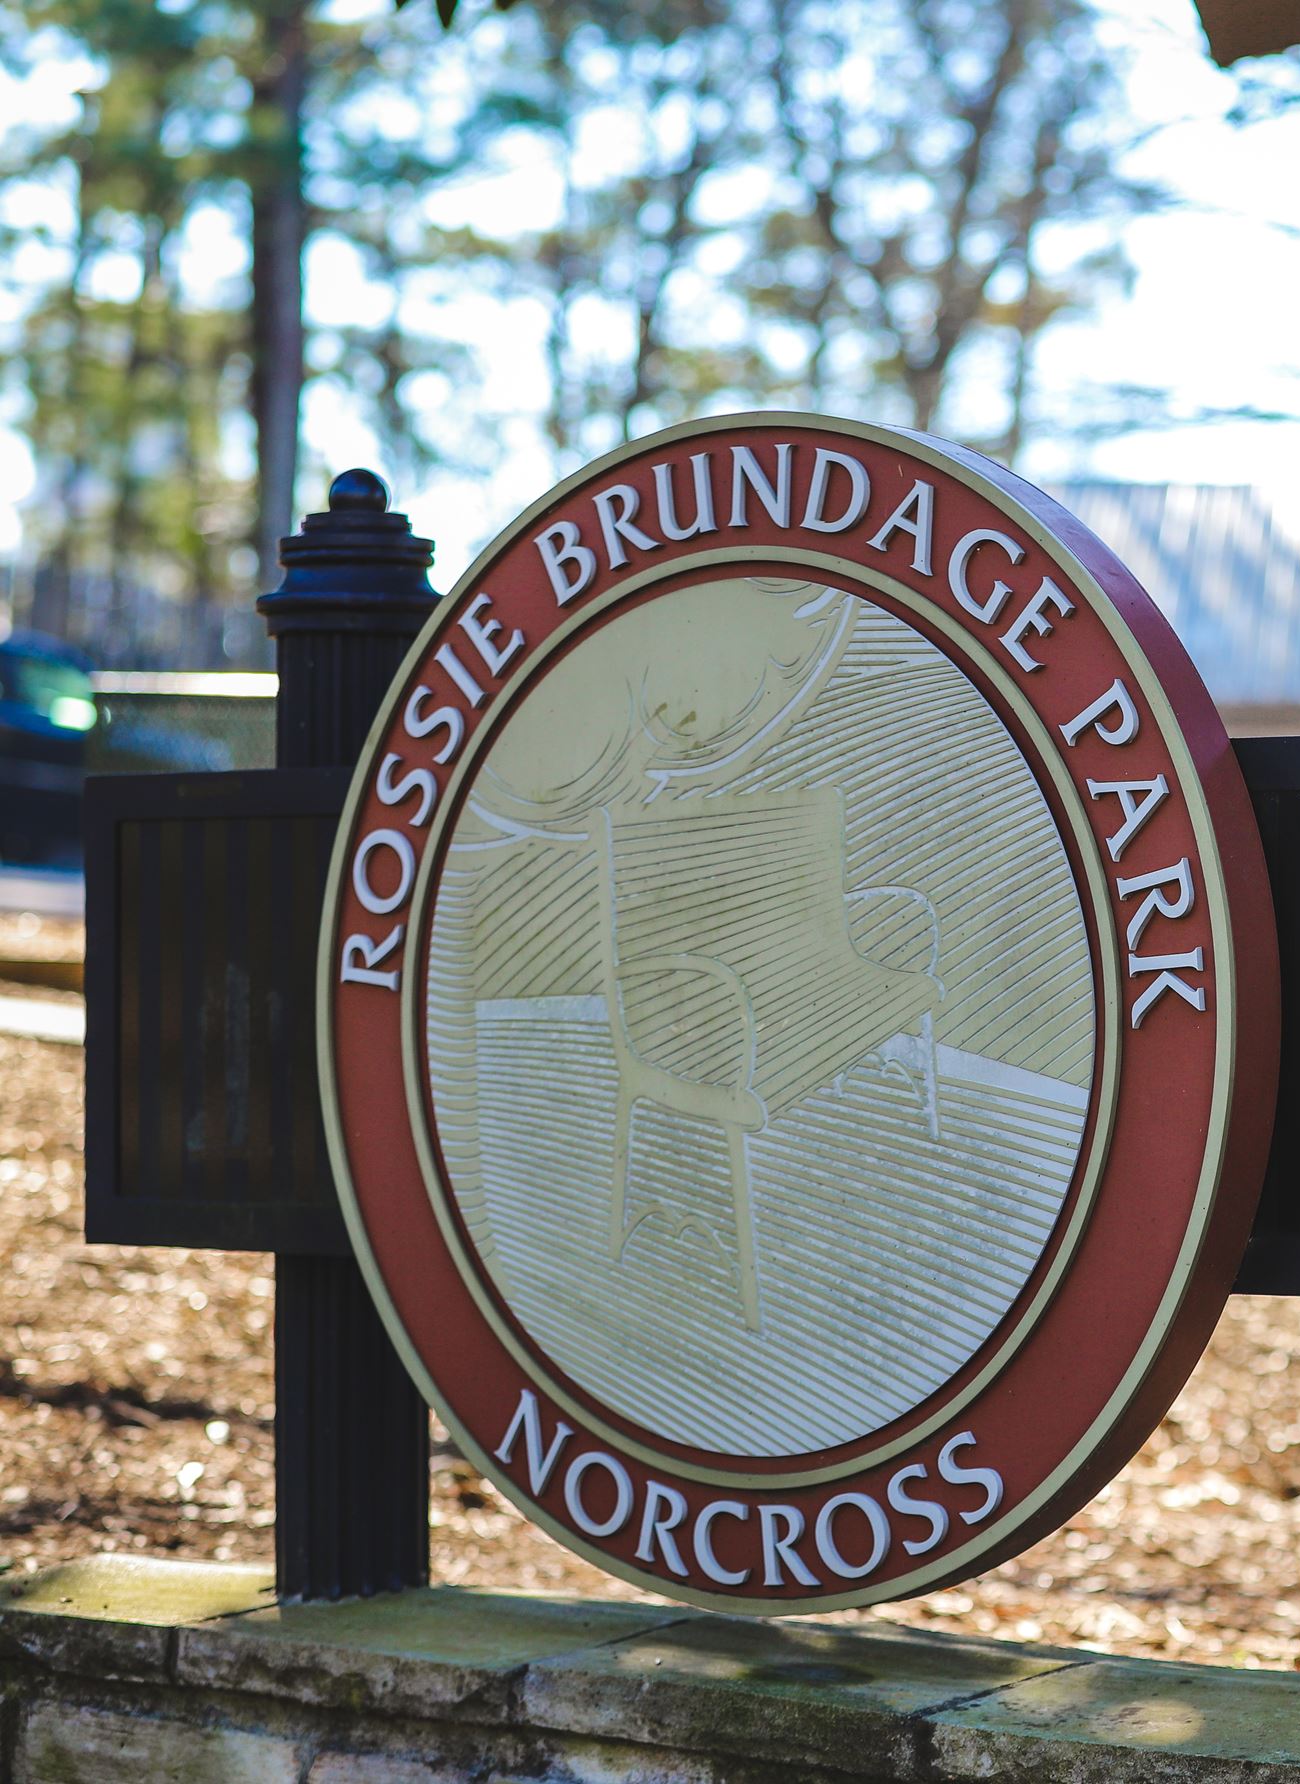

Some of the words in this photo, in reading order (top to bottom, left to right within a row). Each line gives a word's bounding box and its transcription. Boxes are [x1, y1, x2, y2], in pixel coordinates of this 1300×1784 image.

[340, 592, 526, 992] ROSSIE
[533, 443, 1076, 673] BRUNDAGE
[1058, 678, 1206, 1029] PARK
[494, 1389, 1004, 1587] NORCROSS
